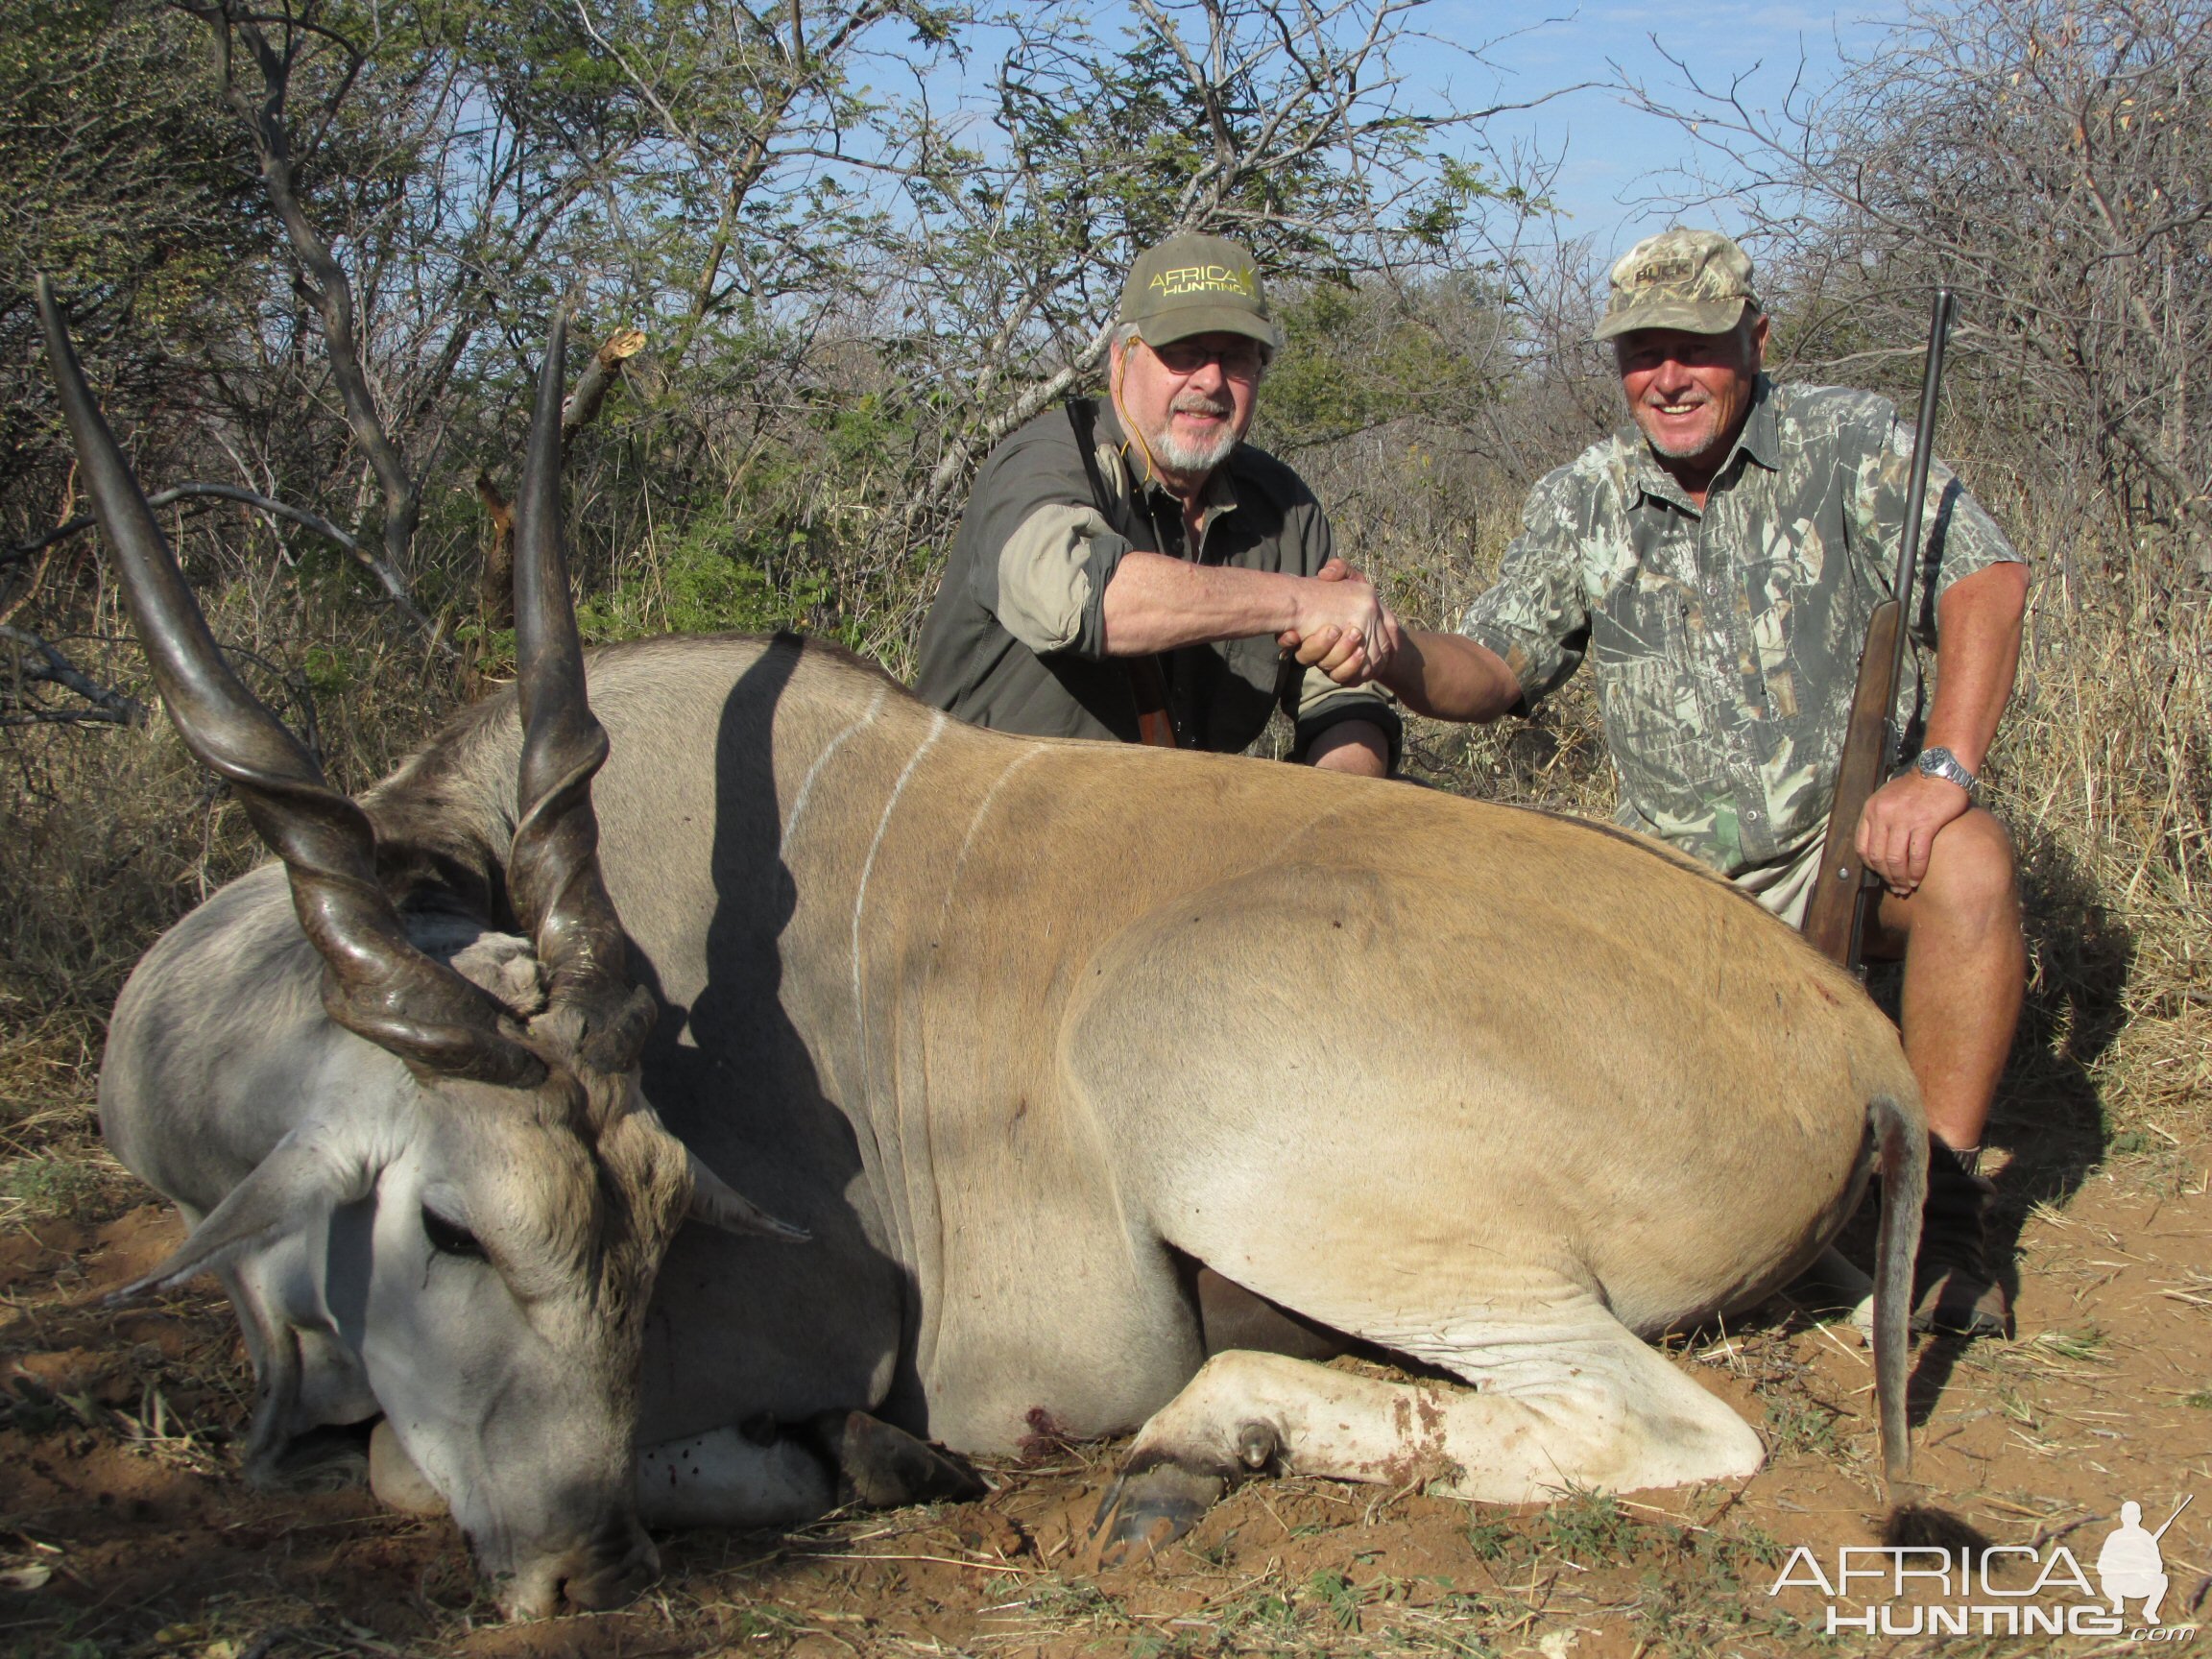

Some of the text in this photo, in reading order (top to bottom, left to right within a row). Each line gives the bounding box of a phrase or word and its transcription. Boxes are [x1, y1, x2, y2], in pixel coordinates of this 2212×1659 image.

[1148, 265, 1237, 290] AFRICA
[1636, 262, 1689, 282] BUCK
[1164, 281, 1246, 297] HUNTING
